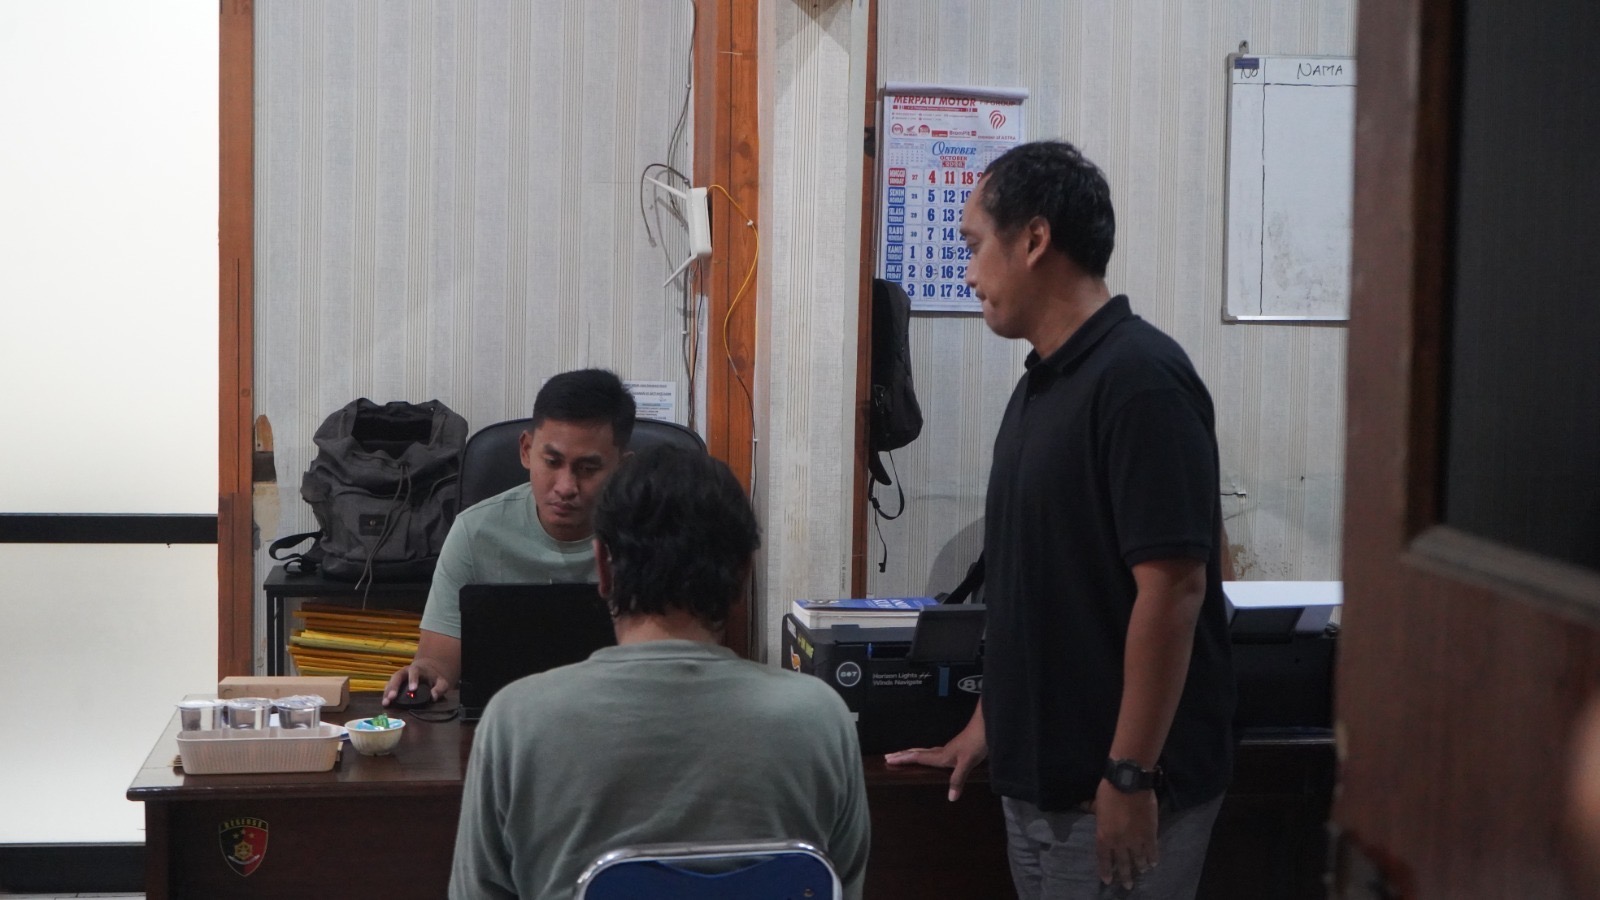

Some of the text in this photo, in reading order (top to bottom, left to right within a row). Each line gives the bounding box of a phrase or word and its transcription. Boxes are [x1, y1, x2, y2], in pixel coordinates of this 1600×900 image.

[1297, 63, 1342, 79] NAMA
[893, 95, 936, 106] MERPATI
[939, 97, 976, 107] MOTOR
[928, 170, 936, 184] 4
[945, 171, 955, 184] 11
[961, 172, 974, 185] 18
[928, 189, 935, 202] 5
[944, 190, 956, 203] 12
[927, 208, 935, 221] 6
[943, 209, 954, 222] 13
[927, 227, 934, 240] 7
[942, 228, 954, 241] 14
[910, 246, 972, 260] 1 8 15 22
[908, 265, 968, 279] 2 9 16 2
[907, 284, 971, 298] 3 10 17 24
[898, 672, 918, 680] Lights
